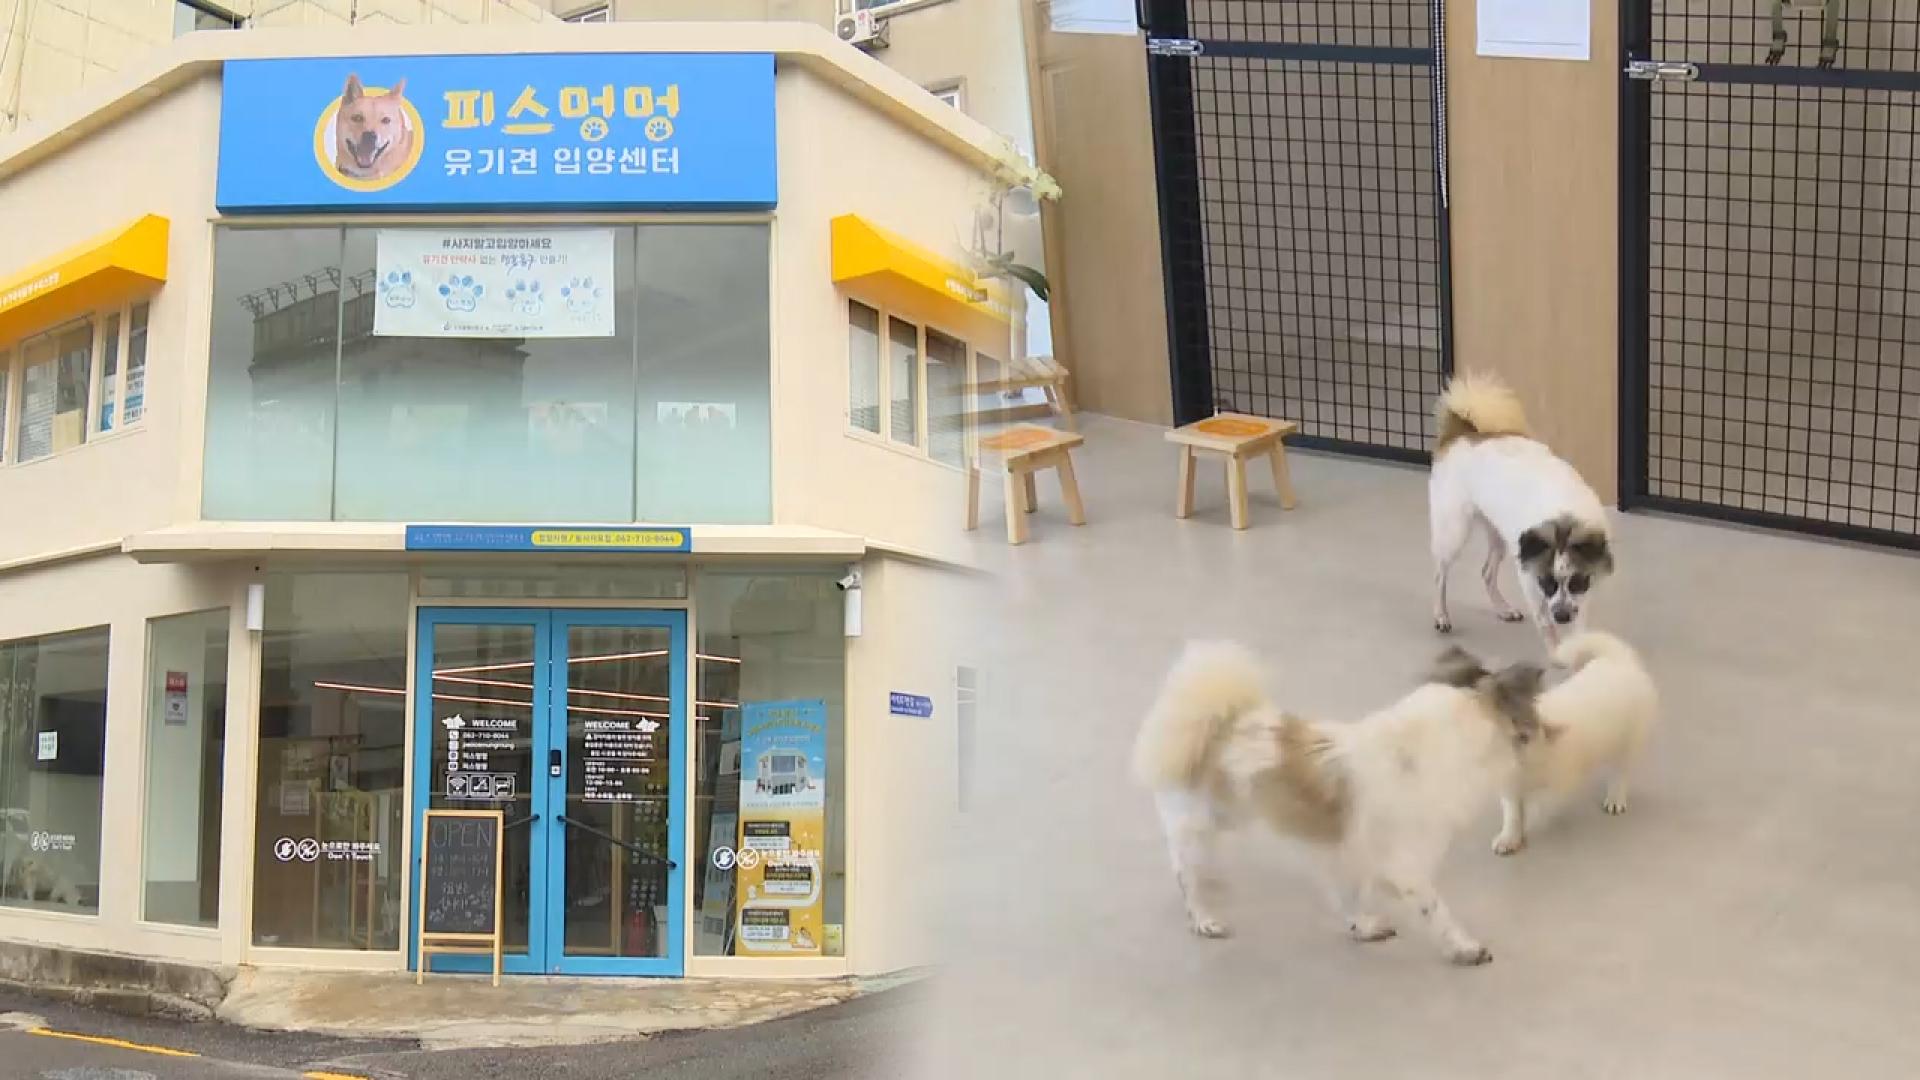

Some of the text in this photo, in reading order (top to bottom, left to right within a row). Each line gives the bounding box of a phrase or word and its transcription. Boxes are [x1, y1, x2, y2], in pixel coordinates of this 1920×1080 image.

[441, 84, 680, 142] 피스멍멍
[443, 147, 679, 177] 유기견 입양센터
[442, 238, 552, 250] #사지말고입양하세요
[472, 719, 517, 728] WELCOME
[584, 720, 630, 730] WELCOME
[431, 821, 493, 848] OPEN
